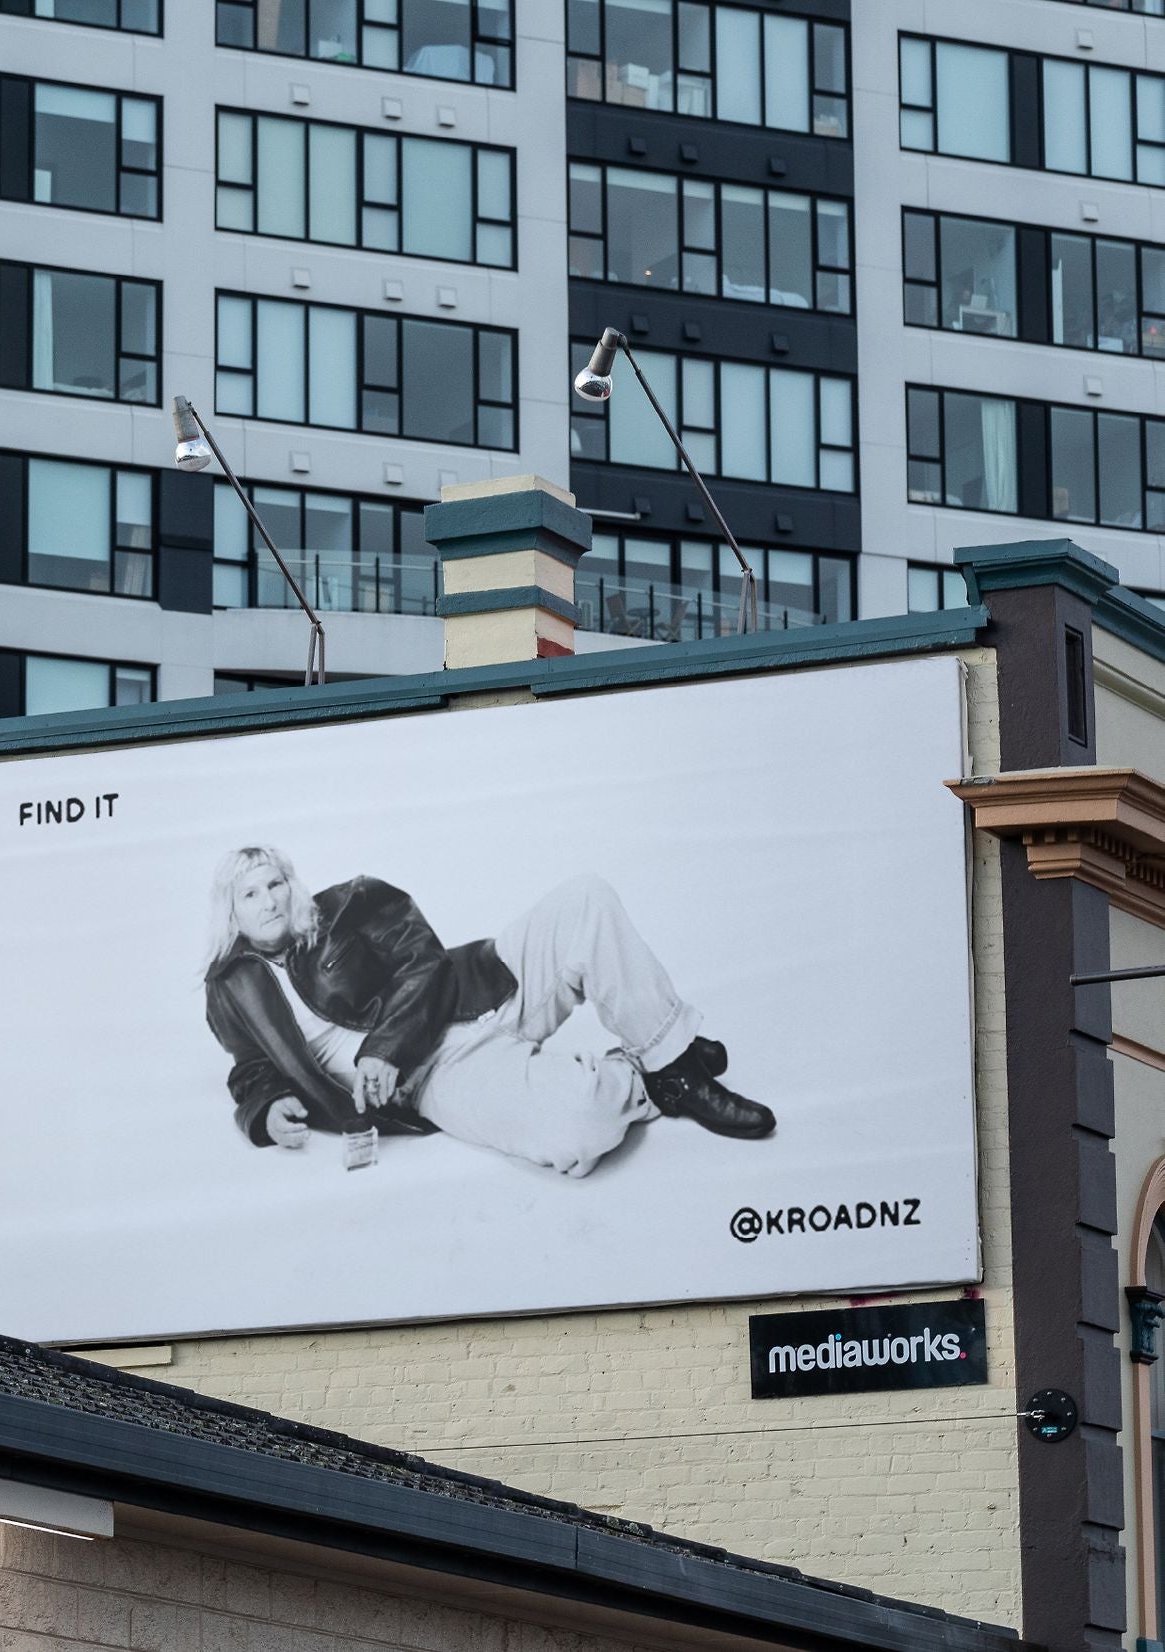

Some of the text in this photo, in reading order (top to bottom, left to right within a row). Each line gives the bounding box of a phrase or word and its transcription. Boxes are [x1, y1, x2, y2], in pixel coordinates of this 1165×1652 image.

[19, 793, 119, 826] FIND IT
[729, 1198, 922, 1243] @KROADNZ
